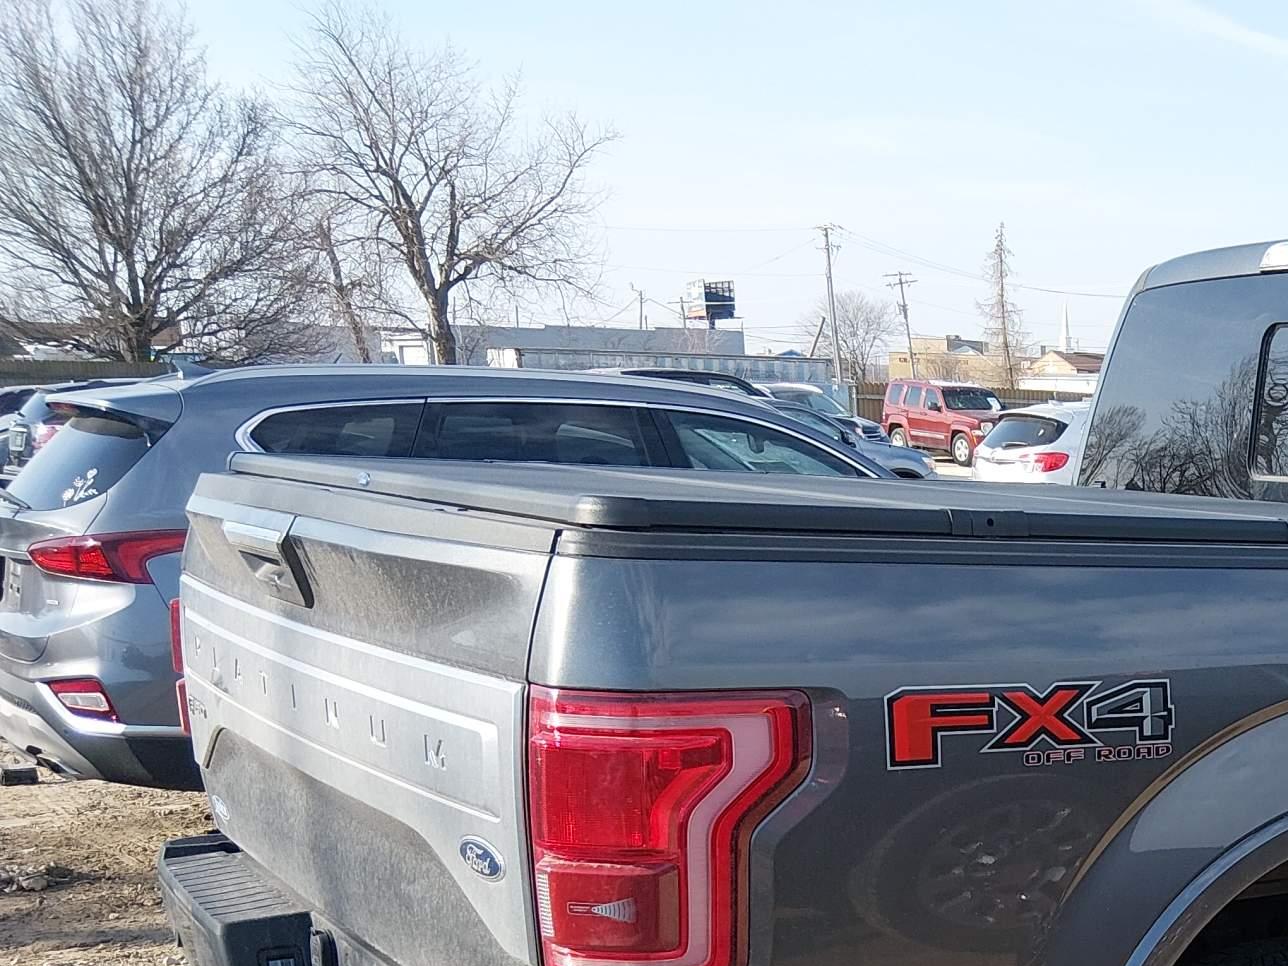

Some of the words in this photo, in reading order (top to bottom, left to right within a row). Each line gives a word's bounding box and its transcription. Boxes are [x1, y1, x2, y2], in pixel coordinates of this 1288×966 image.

[884, 678, 1175, 770] FX4
[1023, 749, 1085, 766] OFF
[1095, 744, 1173, 762] ROAD
[465, 843, 492, 876] Ford
